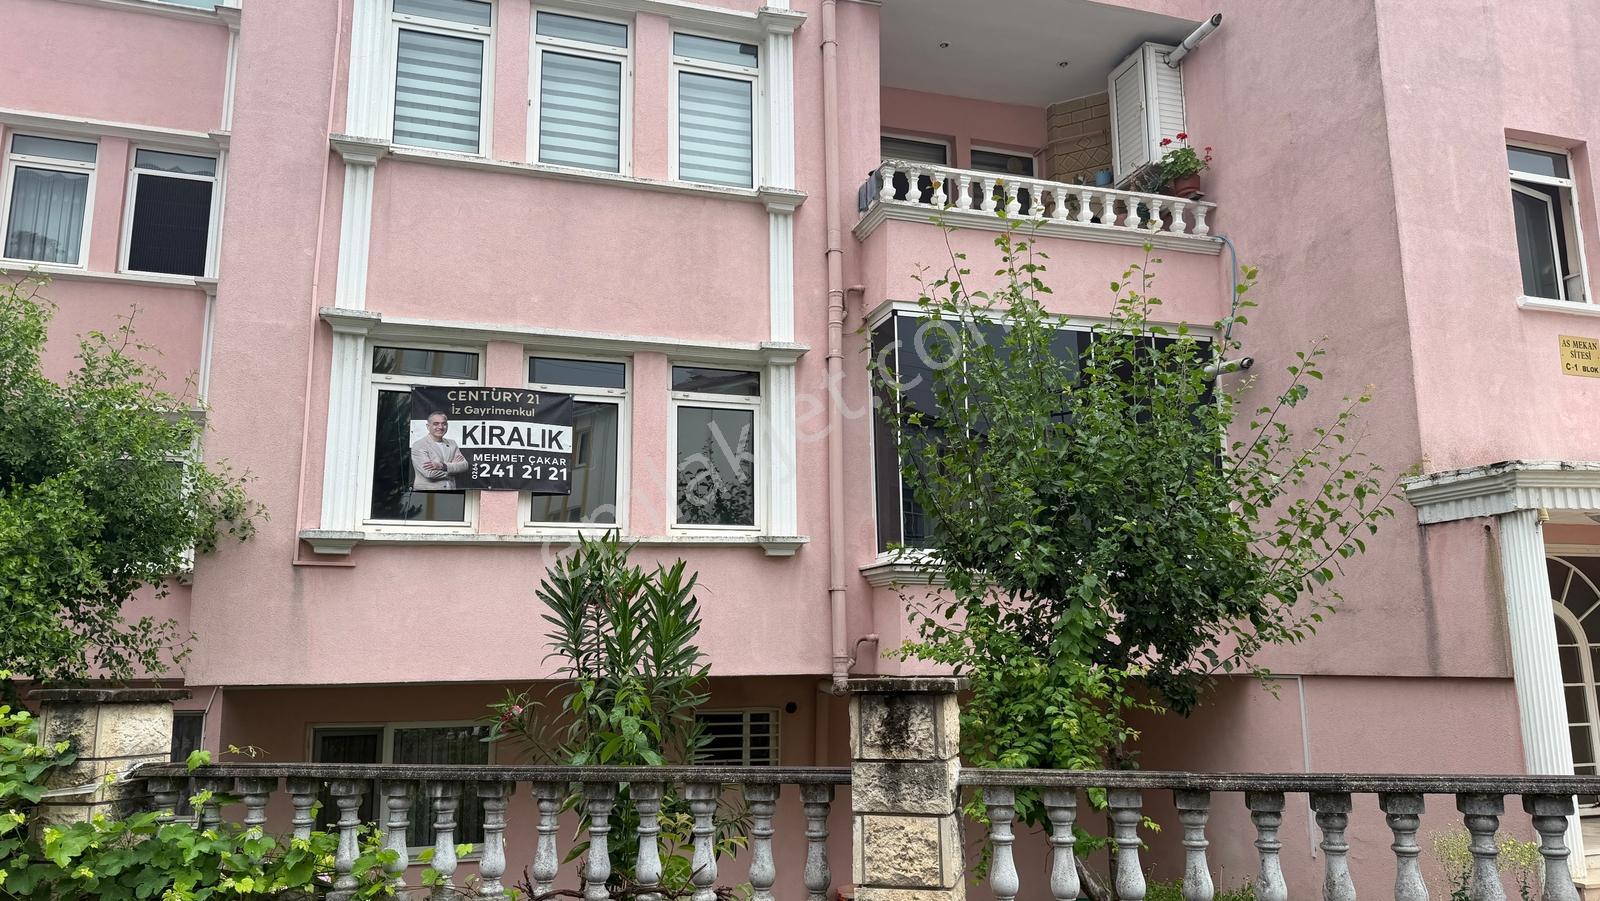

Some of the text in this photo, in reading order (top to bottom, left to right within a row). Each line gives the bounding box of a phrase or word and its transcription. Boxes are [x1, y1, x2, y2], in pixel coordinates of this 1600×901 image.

[1562, 339, 1597, 350] AS MEKAN
[1565, 362, 1599, 373] C-1 BLOK
[527, 393, 540, 405] 21
[464, 405, 535, 417] Gayrimenkul
[462, 421, 564, 450] KİRALIK
[473, 453, 567, 466] MEHMET ÇAKAR
[479, 463, 514, 478] 241
[521, 464, 541, 480] 21
[548, 466, 567, 481] 21
